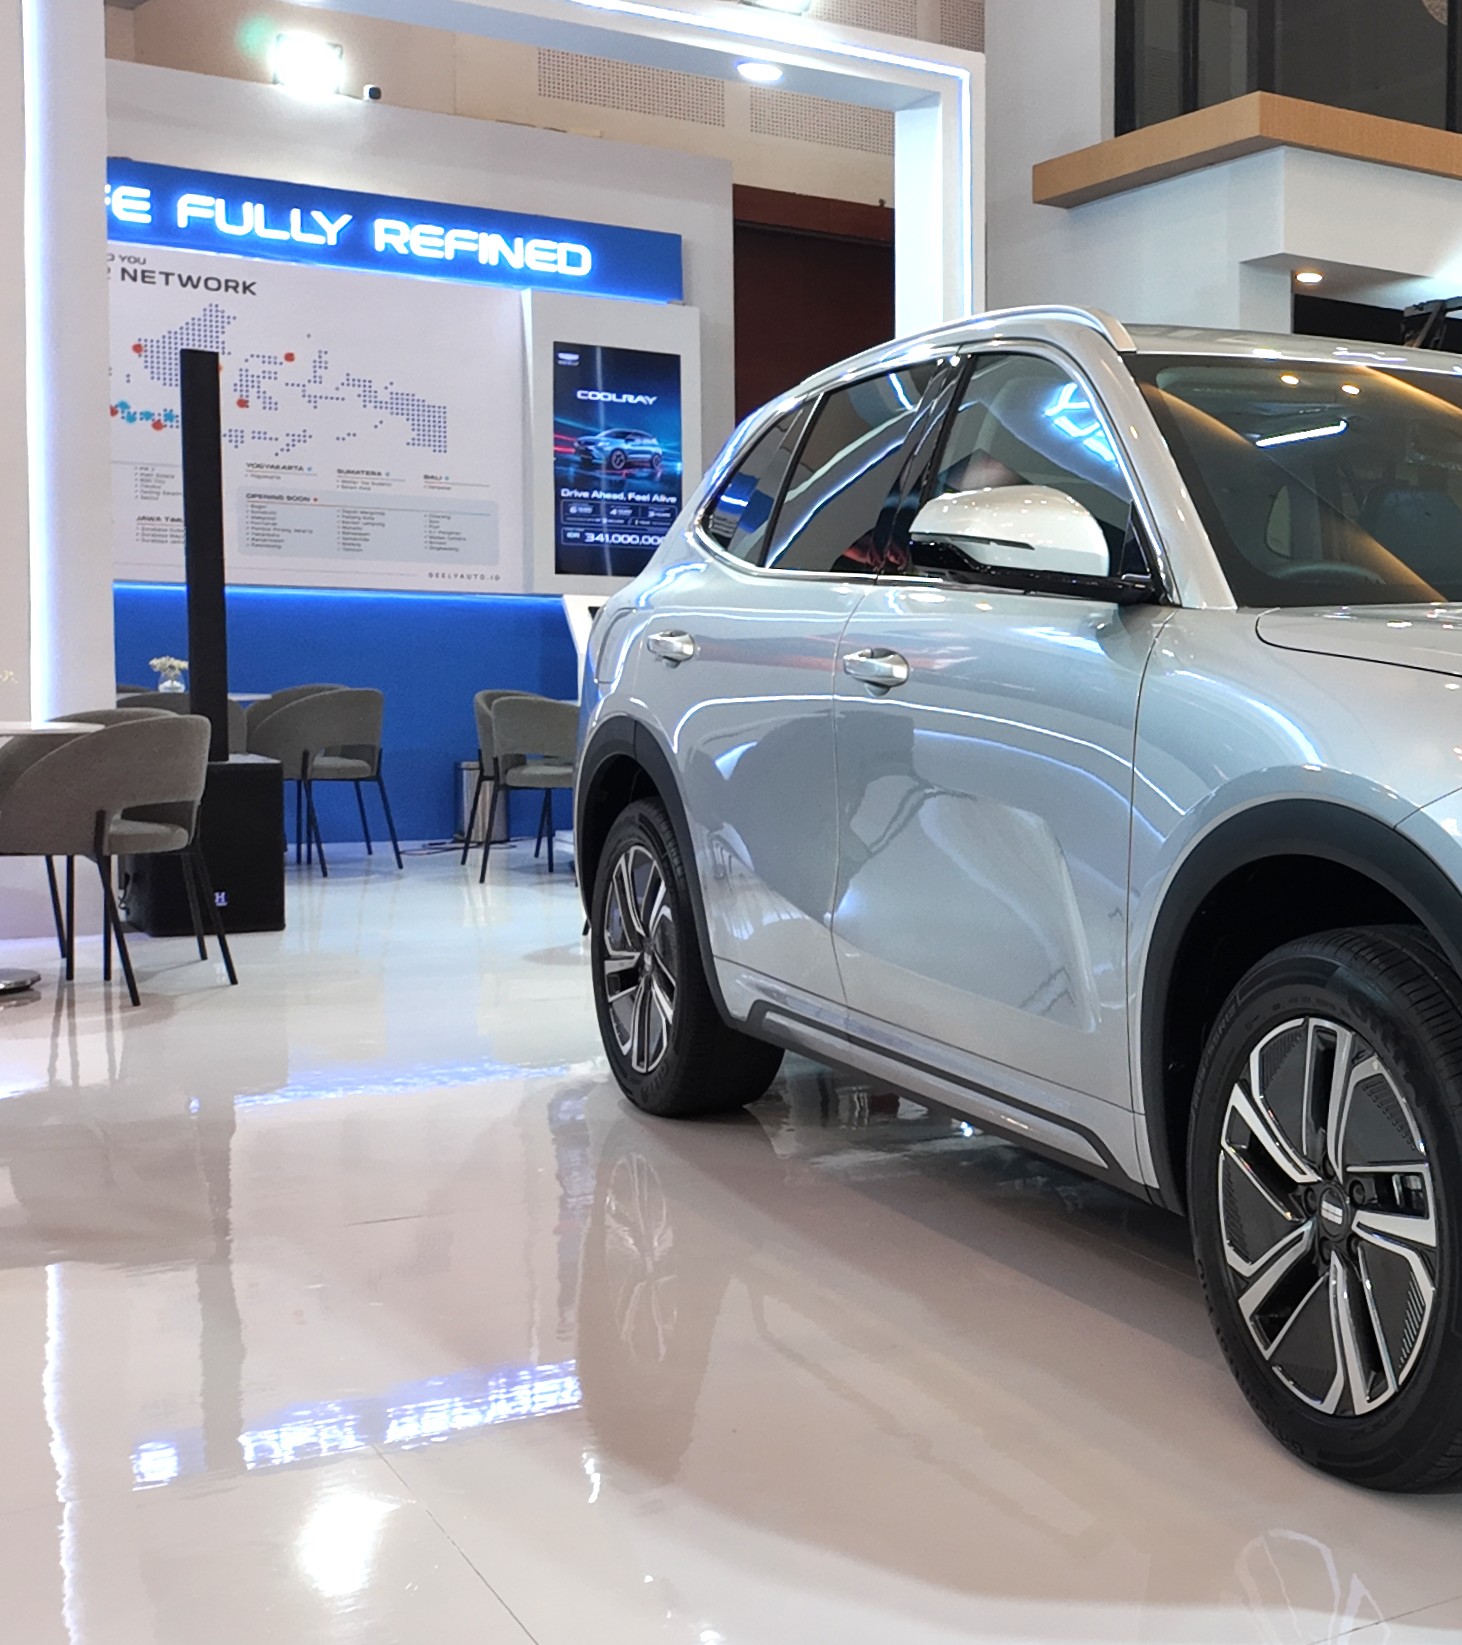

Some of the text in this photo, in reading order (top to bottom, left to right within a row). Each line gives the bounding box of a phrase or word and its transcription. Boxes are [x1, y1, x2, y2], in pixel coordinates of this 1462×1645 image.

[177, 193, 352, 245] FULLY
[374, 218, 592, 276] REFINED
[118, 254, 147, 265] YOU
[120, 266, 257, 296] NETWORK
[576, 390, 658, 405] COOLRAY
[561, 488, 677, 504] Drive Ahead, Feel Alive
